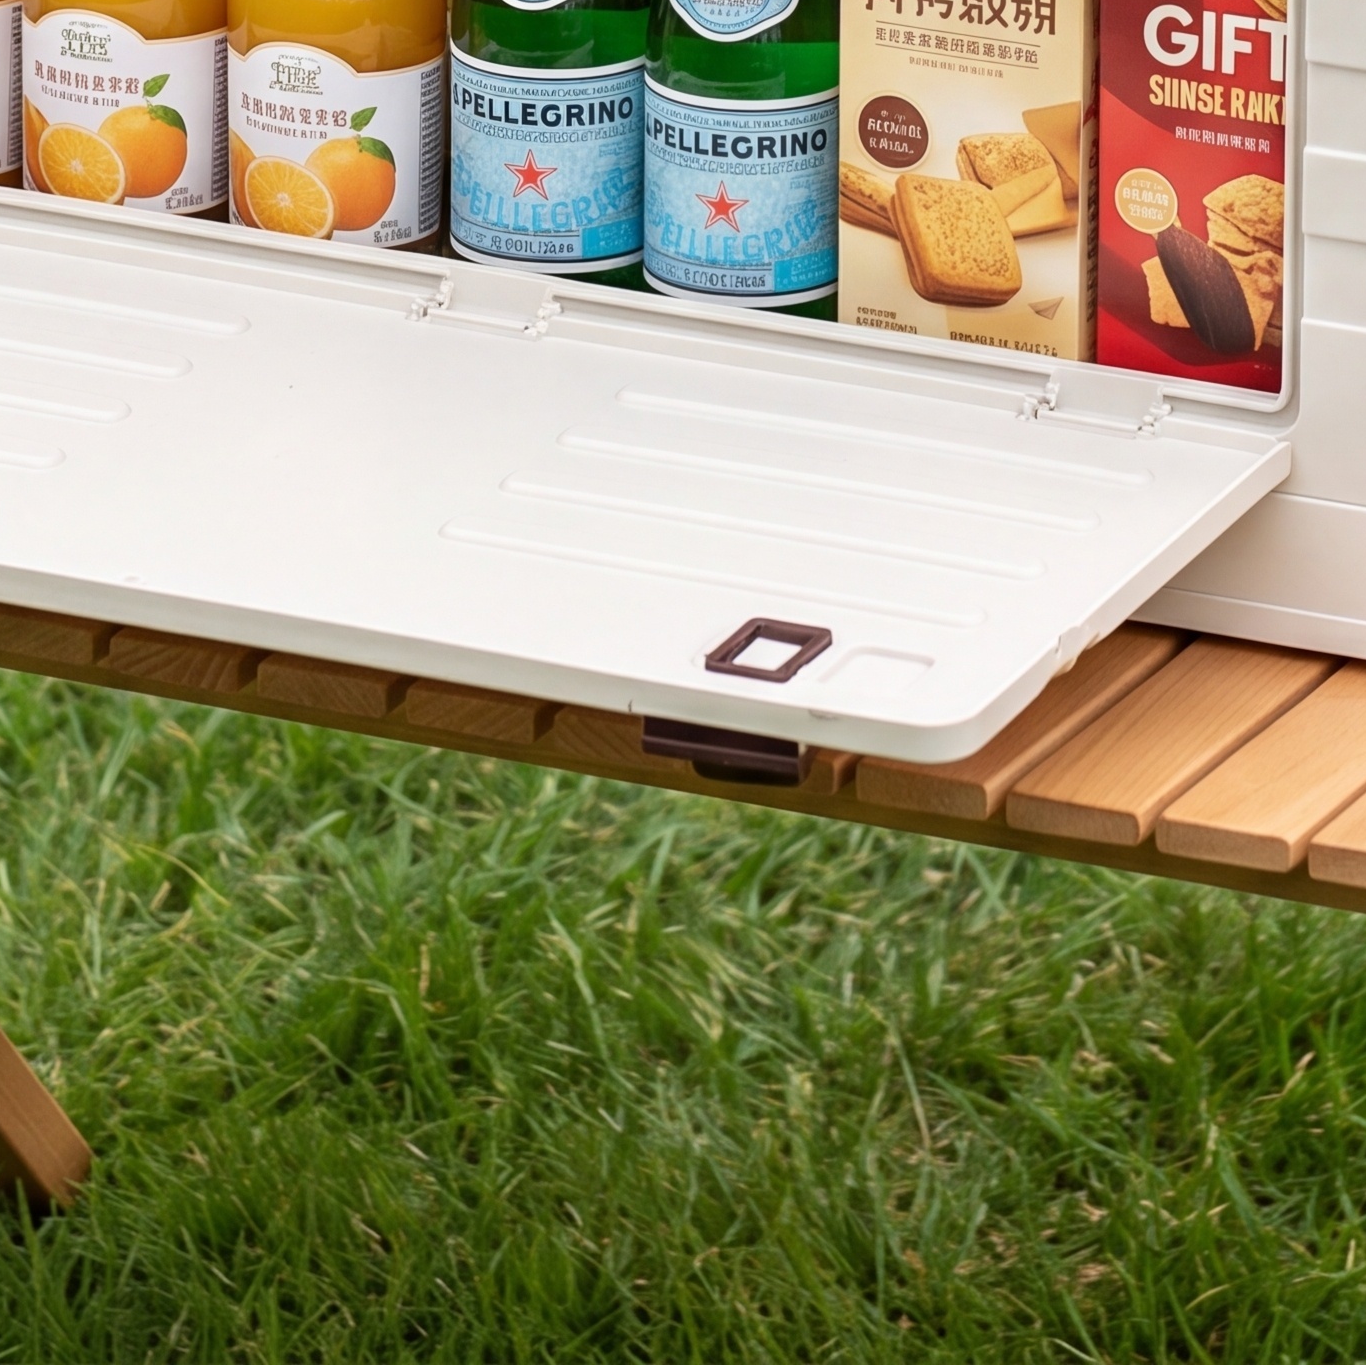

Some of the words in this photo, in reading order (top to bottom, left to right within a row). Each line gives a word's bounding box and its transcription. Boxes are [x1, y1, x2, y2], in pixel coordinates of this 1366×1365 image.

[1143, 4, 1287, 82] GIFT
[462, 91, 634, 128] PELLEGRINO
[653, 118, 828, 160] PELLEGRINO
